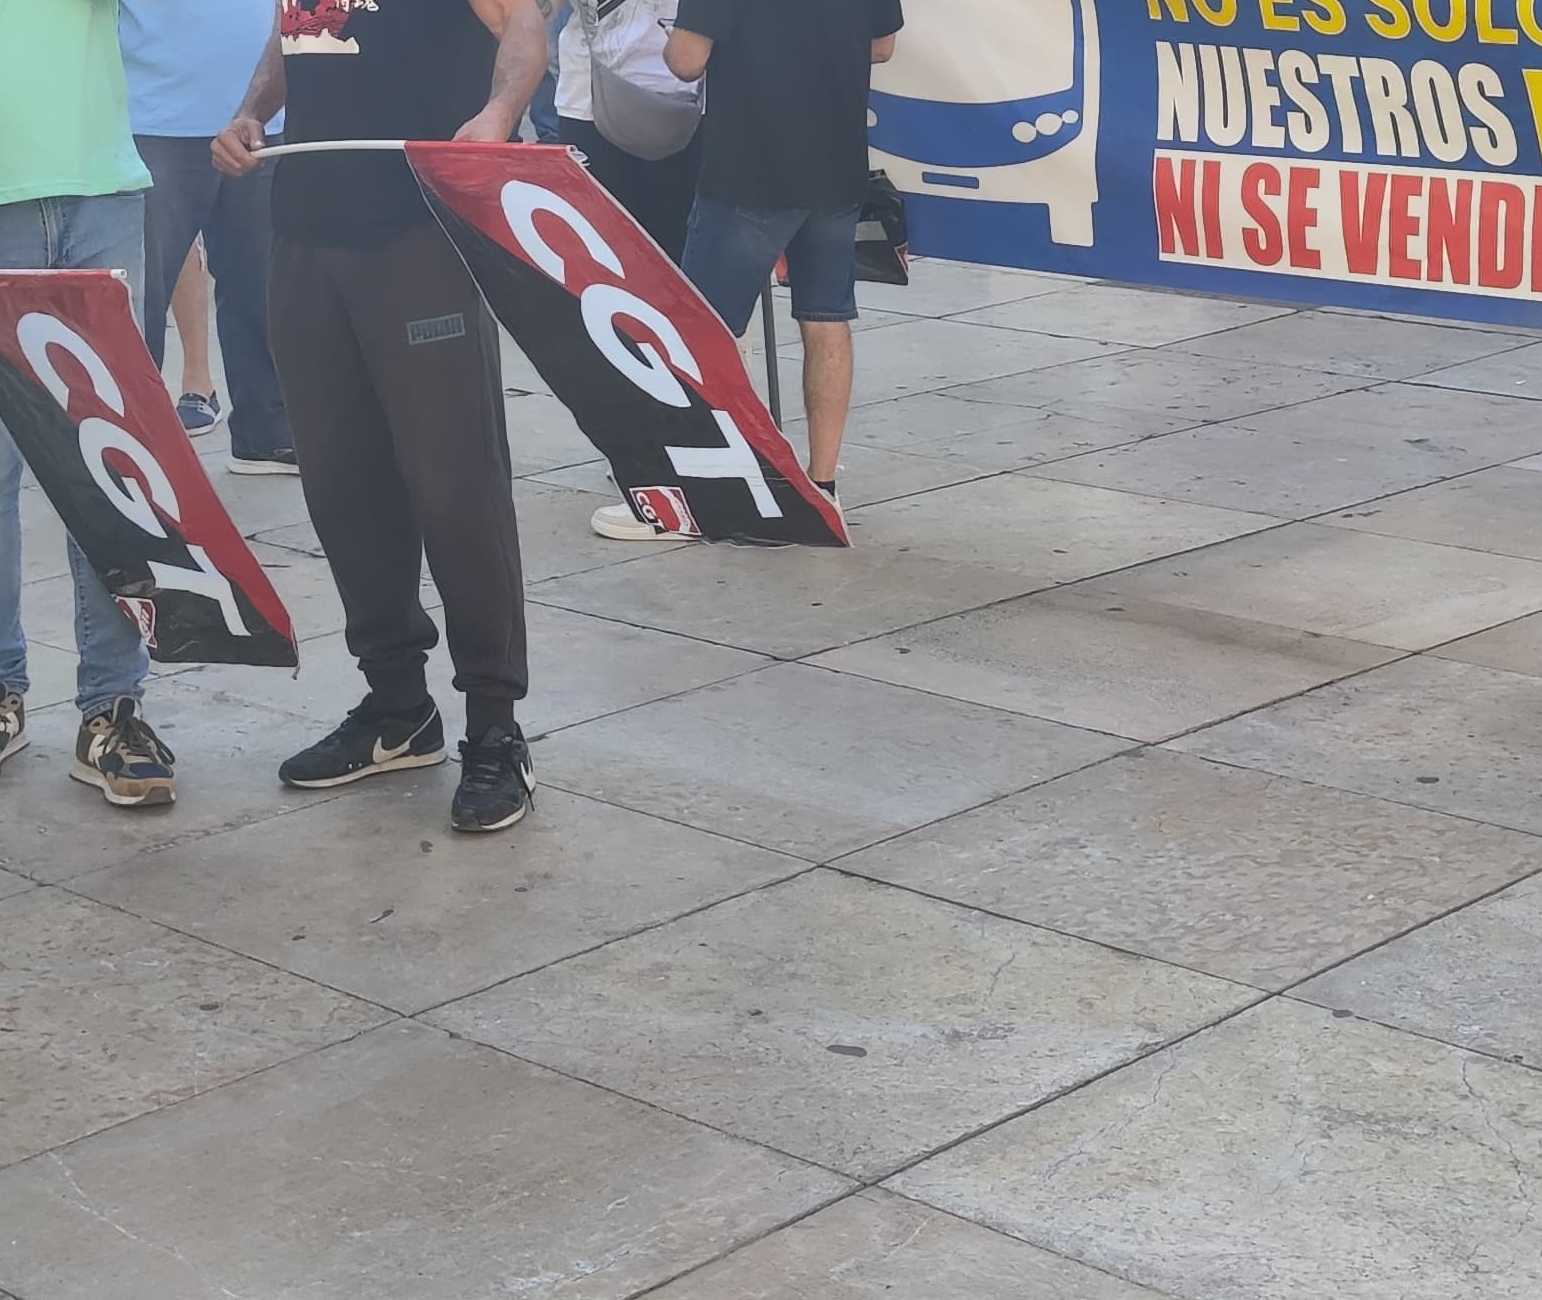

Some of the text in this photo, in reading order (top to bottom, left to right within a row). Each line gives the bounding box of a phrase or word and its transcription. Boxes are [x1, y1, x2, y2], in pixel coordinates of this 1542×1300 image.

[1153, 156, 1222, 260] NI
[1241, 161, 1322, 270] SE
[1155, 40, 1520, 167] NUESTROS
[500, 179, 784, 519] CGT
[16, 311, 253, 638] CGT
